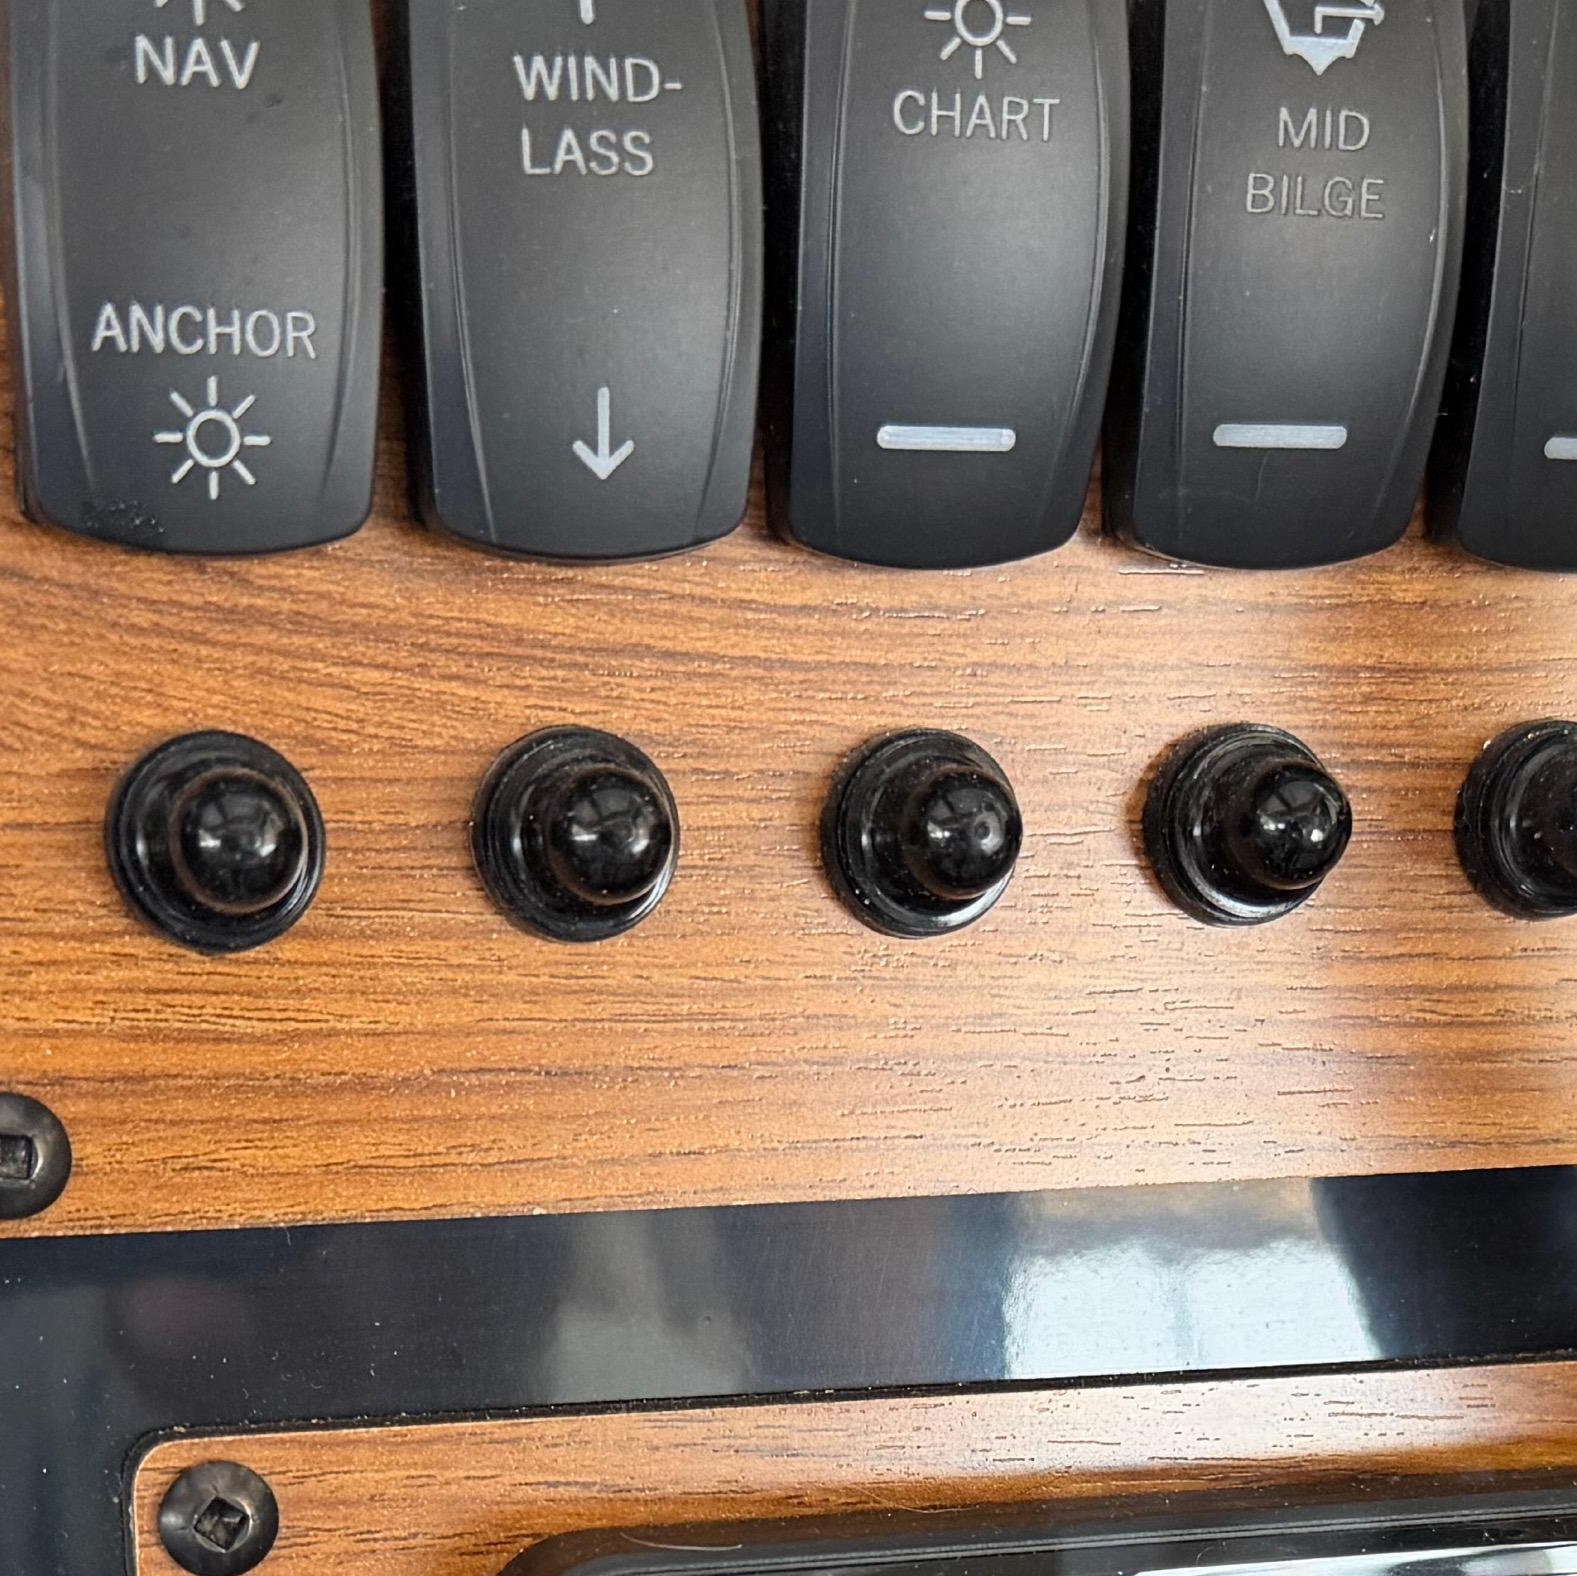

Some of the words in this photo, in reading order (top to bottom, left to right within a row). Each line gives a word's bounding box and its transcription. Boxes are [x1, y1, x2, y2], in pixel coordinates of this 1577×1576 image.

[134, 35, 260, 90] NAV
[512, 54, 682, 103] WIND-
[891, 89, 1061, 143] CHART
[1276, 106, 1371, 152] MID
[521, 129, 655, 177] LASS
[1244, 173, 1385, 220] BILGE
[91, 301, 316, 360] ANCHOR
